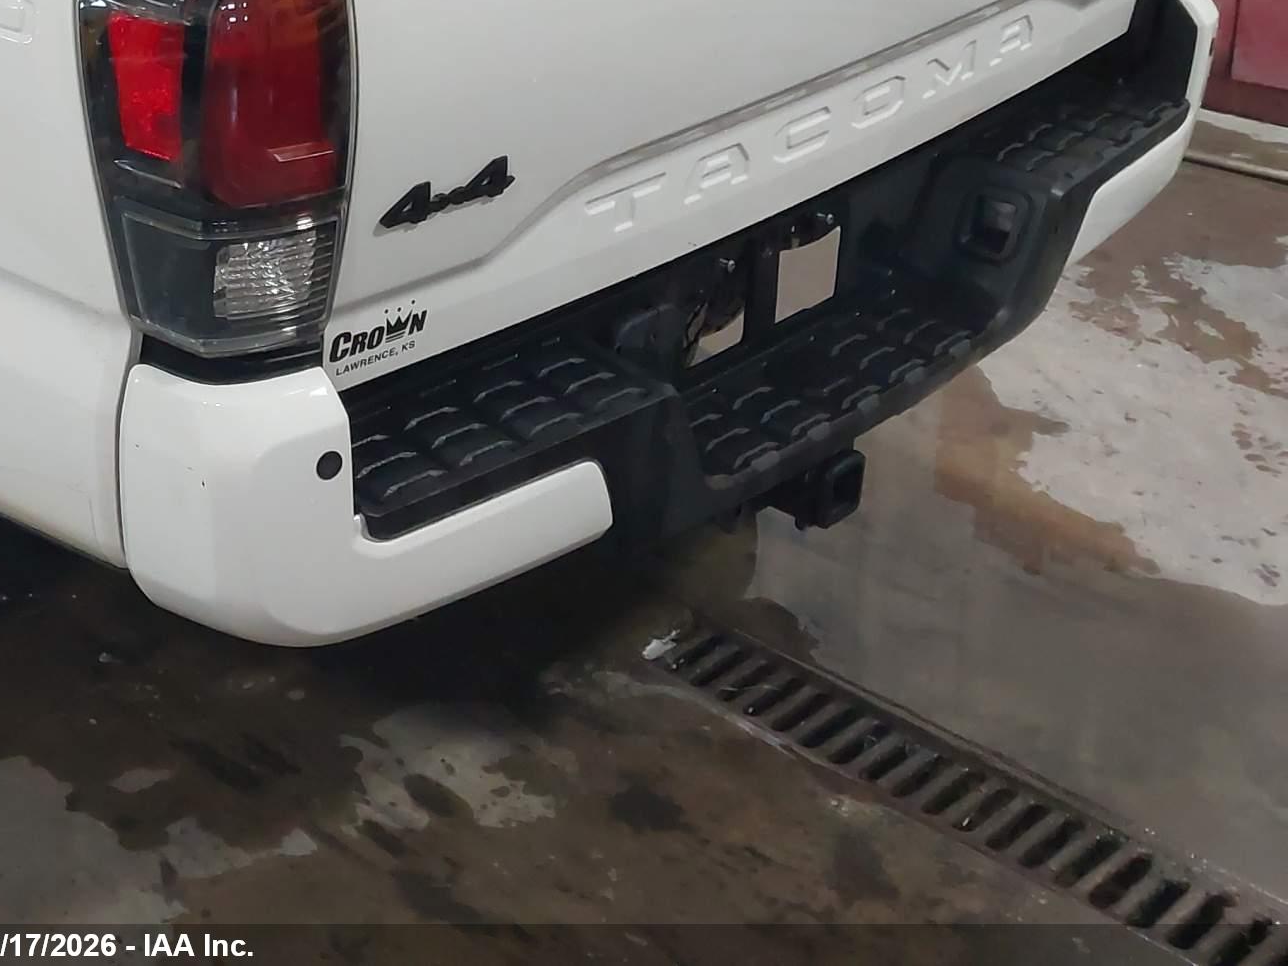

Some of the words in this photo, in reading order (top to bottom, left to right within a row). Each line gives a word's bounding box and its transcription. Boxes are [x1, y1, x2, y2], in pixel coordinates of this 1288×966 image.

[584, 14, 1034, 233] TACOMA
[335, 349, 399, 376] LAWRENCE,
[401, 340, 416, 353] KS
